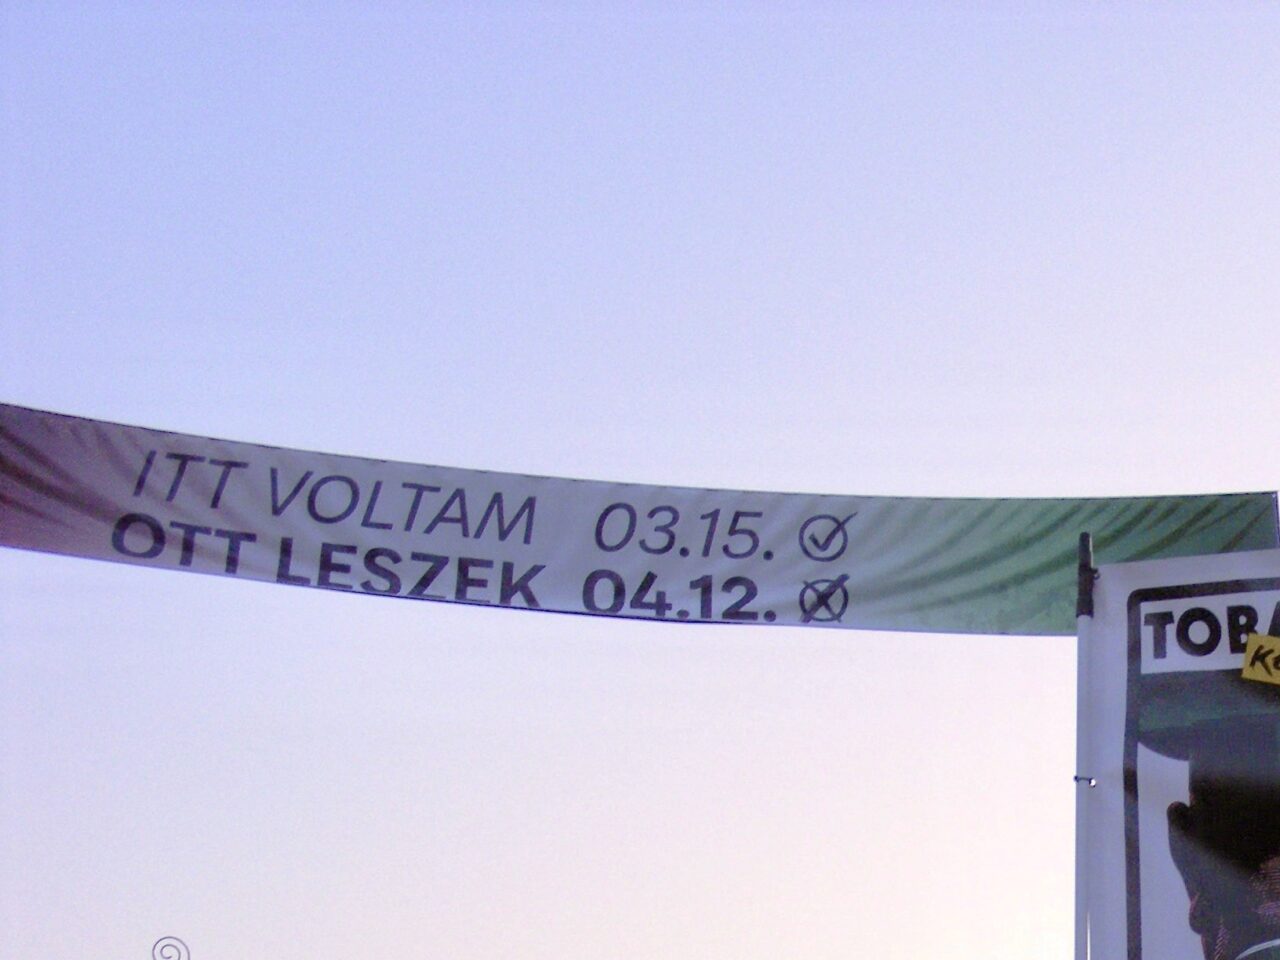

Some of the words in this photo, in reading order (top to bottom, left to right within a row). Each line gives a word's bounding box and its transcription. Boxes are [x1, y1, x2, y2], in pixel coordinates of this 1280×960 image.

[133, 450, 249, 509] ITT
[270, 467, 537, 545] VOLTAM
[594, 502, 774, 561] 03.15.
[111, 512, 257, 574] OTT
[276, 537, 546, 608] LESZEK
[582, 569, 777, 623] 04.12.
